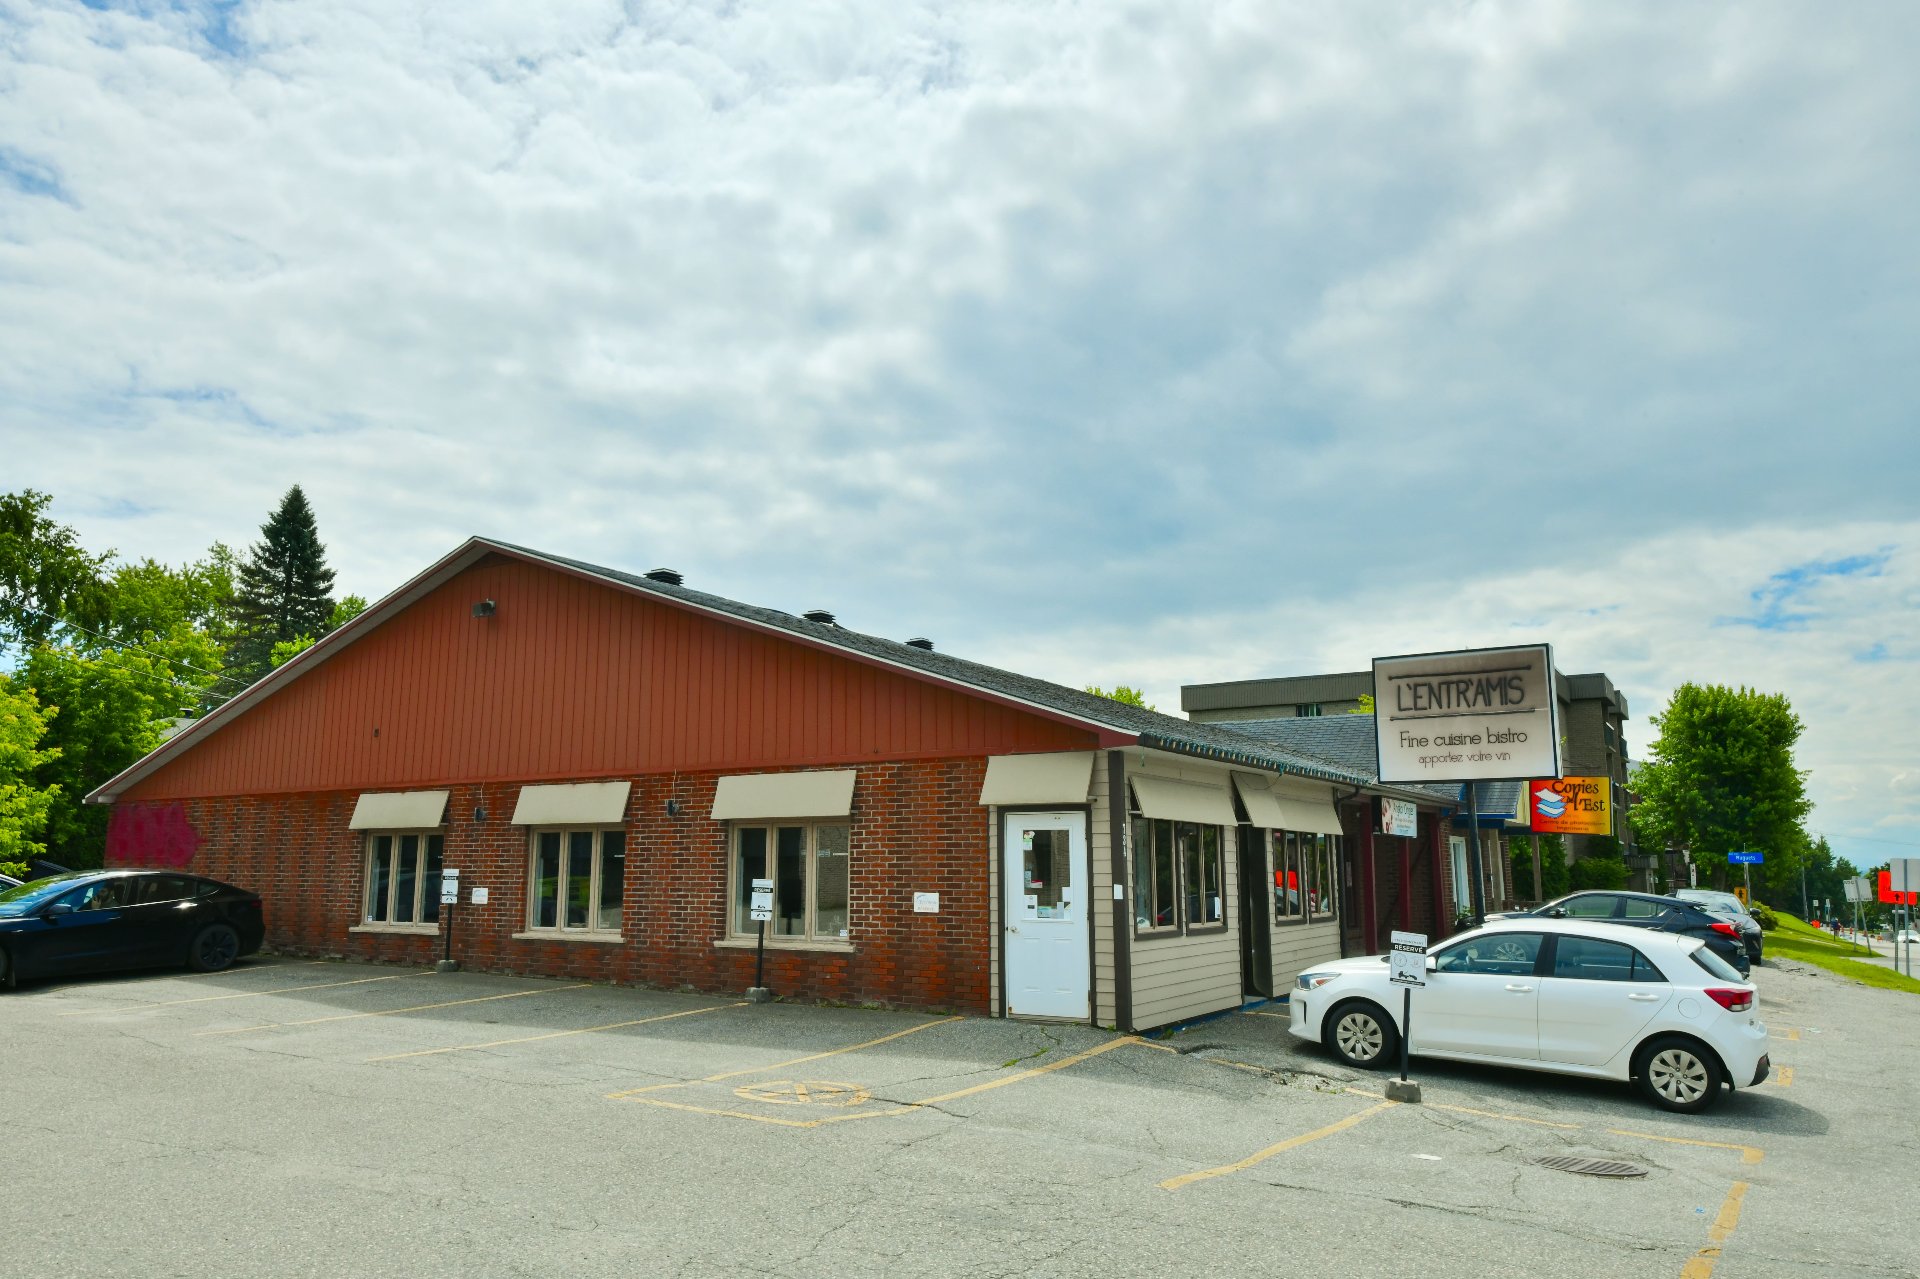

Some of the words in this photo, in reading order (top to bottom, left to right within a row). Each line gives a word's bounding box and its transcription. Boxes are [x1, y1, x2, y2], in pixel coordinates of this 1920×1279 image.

[1397, 676, 1525, 712] L'ENTR'AMIS
[1400, 730, 1429, 748] Fine
[1433, 733, 1482, 747] cuisine
[1486, 726, 1528, 744] bistro
[1418, 752, 1463, 768] apportez
[1466, 750, 1493, 762] votre
[1495, 752, 1511, 761] vin
[1552, 779, 1600, 796] Copies
